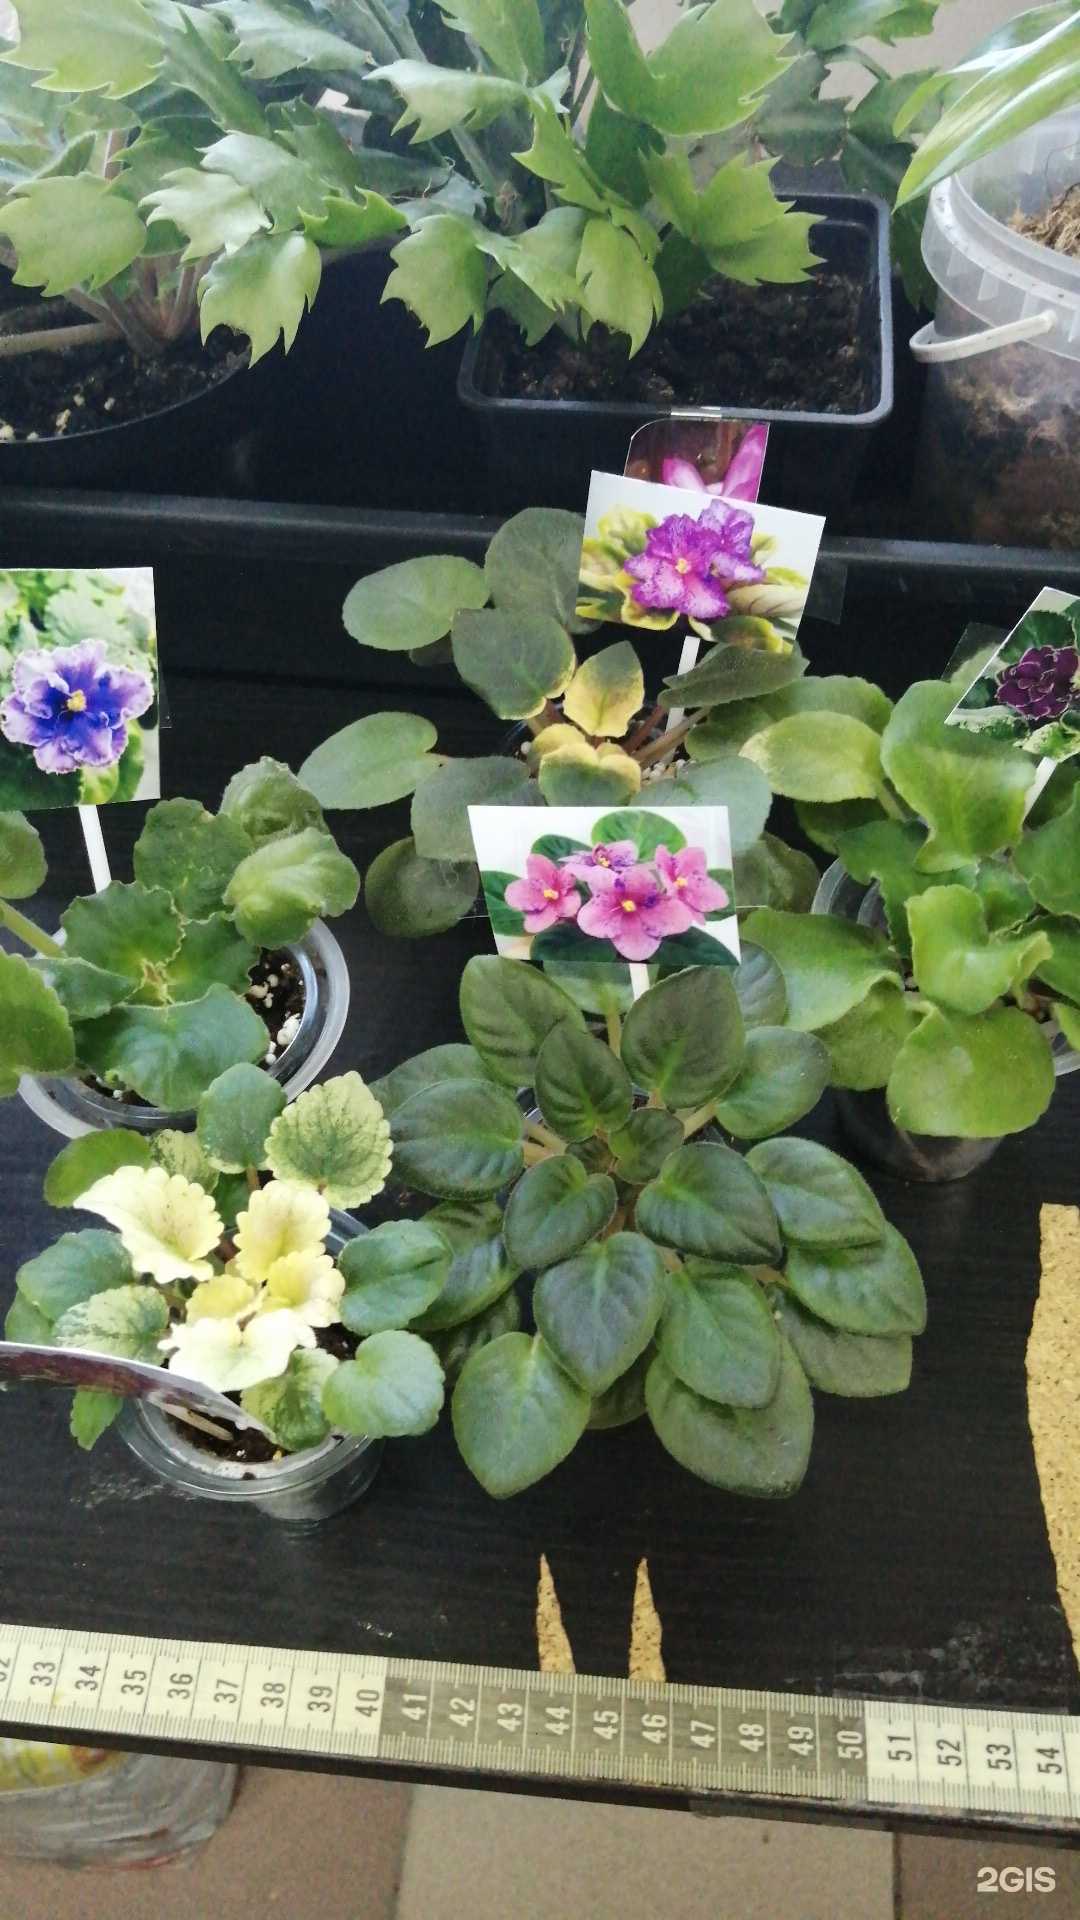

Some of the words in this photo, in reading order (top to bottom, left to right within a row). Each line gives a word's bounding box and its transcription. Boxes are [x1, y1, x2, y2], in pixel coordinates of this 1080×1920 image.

[30, 1662, 56, 1687] 33
[75, 1665, 101, 1691] 34
[121, 1670, 147, 1695] 35
[168, 1673, 193, 1700] 36
[214, 1679, 239, 1704] 37
[261, 1682, 286, 1709] 38
[307, 1685, 333, 1713] 39
[355, 1689, 380, 1718] 40
[402, 1693, 428, 1721] 41
[449, 1698, 476, 1727] 42
[497, 1703, 523, 1733] 43
[544, 1706, 570, 1736] 44
[592, 1710, 620, 1740] 45
[641, 1714, 668, 1745] 46
[690, 1719, 716, 1749] 47
[739, 1723, 765, 1753] 48
[788, 1726, 815, 1757] 49
[837, 1730, 864, 1760] 50
[887, 1734, 913, 1762] 51
[935, 1738, 963, 1767] 52
[987, 1743, 1012, 1771] 53
[1036, 1747, 1063, 1775] 54
